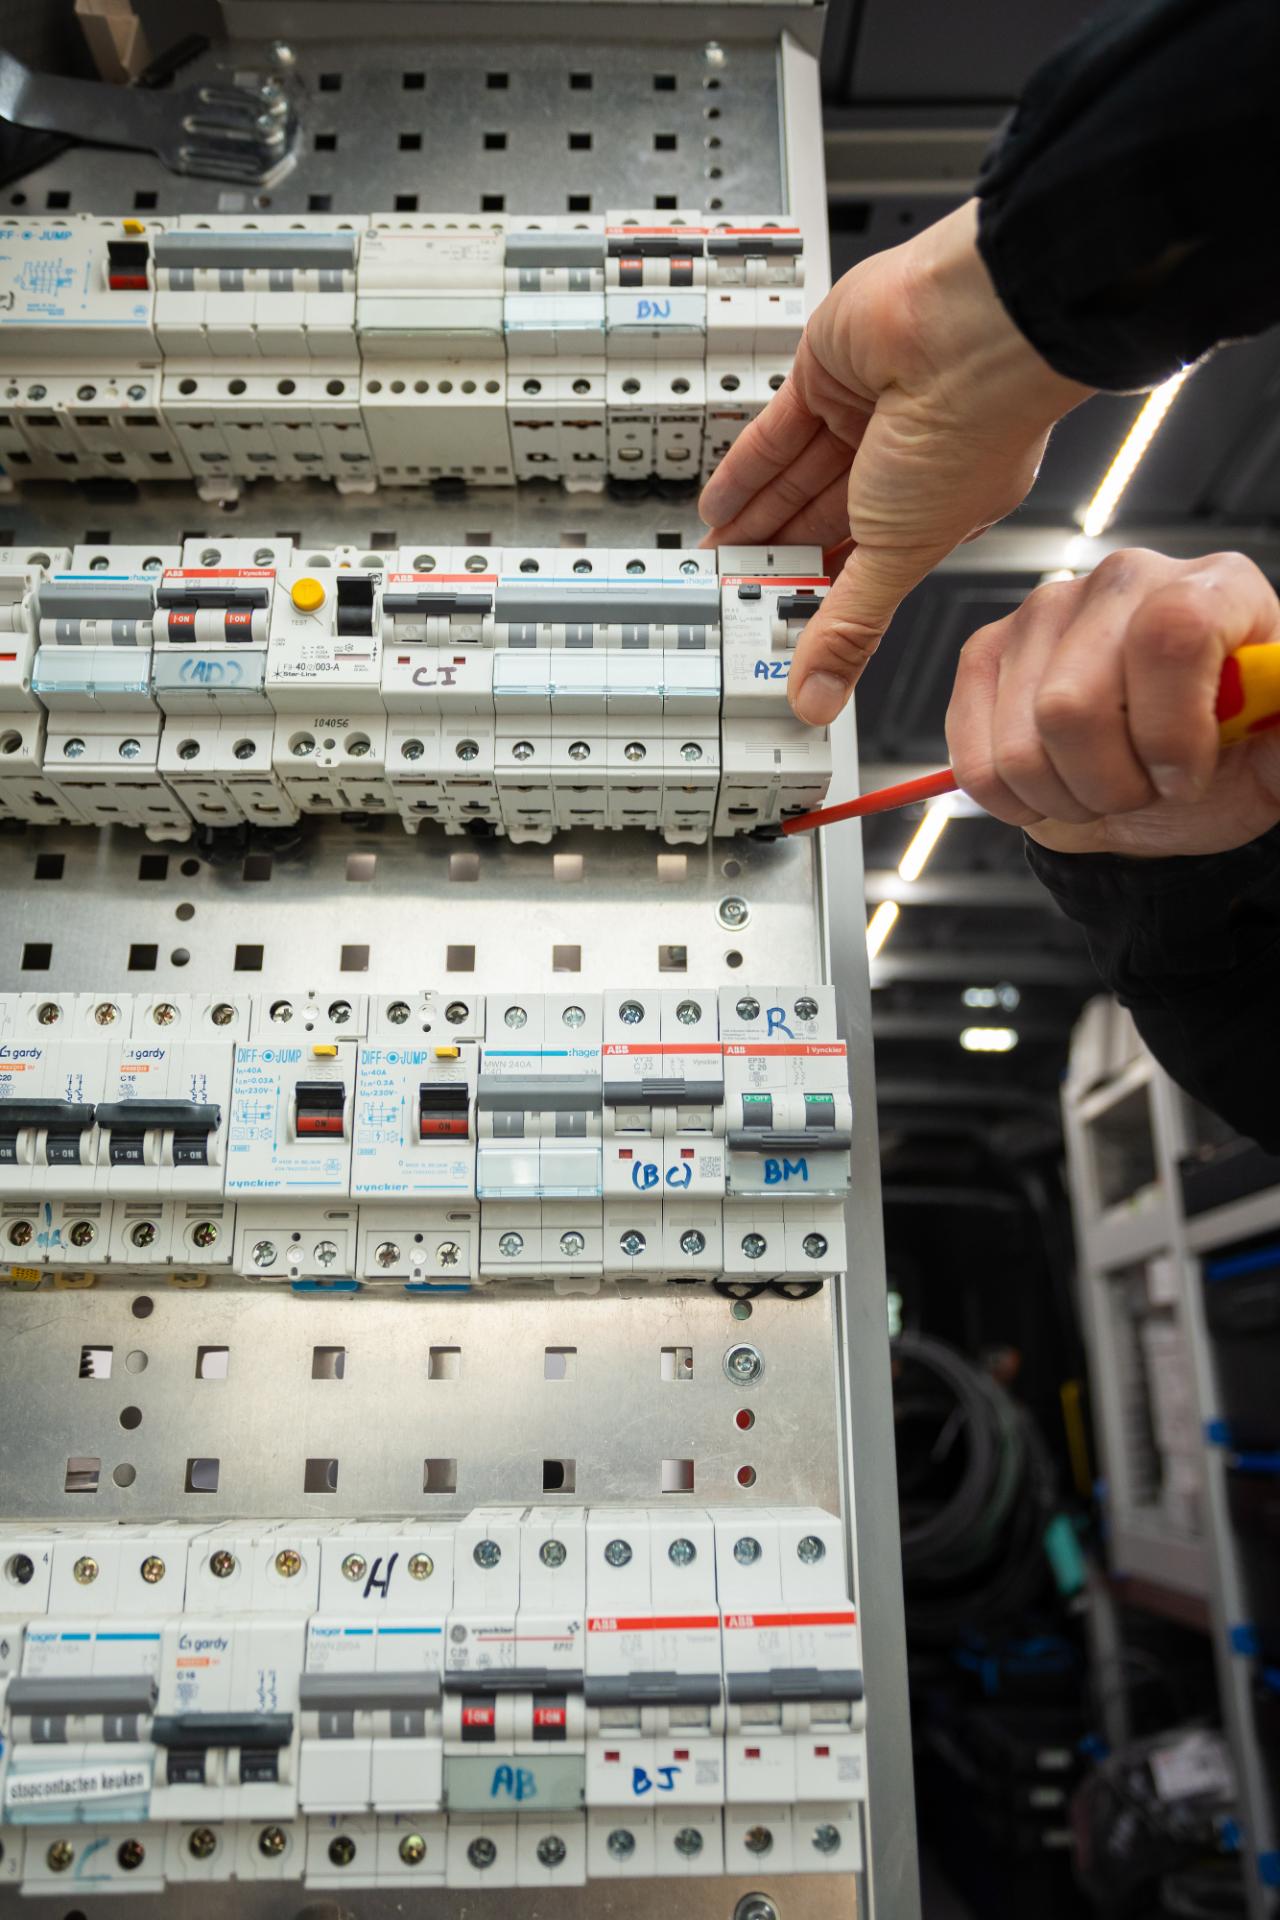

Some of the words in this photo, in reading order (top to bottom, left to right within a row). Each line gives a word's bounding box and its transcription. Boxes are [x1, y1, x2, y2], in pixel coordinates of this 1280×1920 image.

[39, 231, 73, 241] JUMP
[635, 299, 671, 320] BN
[393, 574, 414, 582] ABB
[766, 1007, 795, 1039] R
[12, 1047, 42, 1060] gardy
[135, 1047, 165, 1060] gardy
[606, 1046, 629, 1054] ABB
[726, 1046, 746, 1054] ABB
[763, 1157, 809, 1185] BM
[228, 1180, 281, 1188] vynckier
[355, 1183, 408, 1192] vynckier
[363, 1551, 399, 1599] H
[591, 1618, 618, 1631] ABB
[729, 1615, 755, 1628] ABB
[194, 1637, 228, 1653] gardy
[101, 1769, 145, 1790] keuken
[490, 1764, 538, 1801] AB
